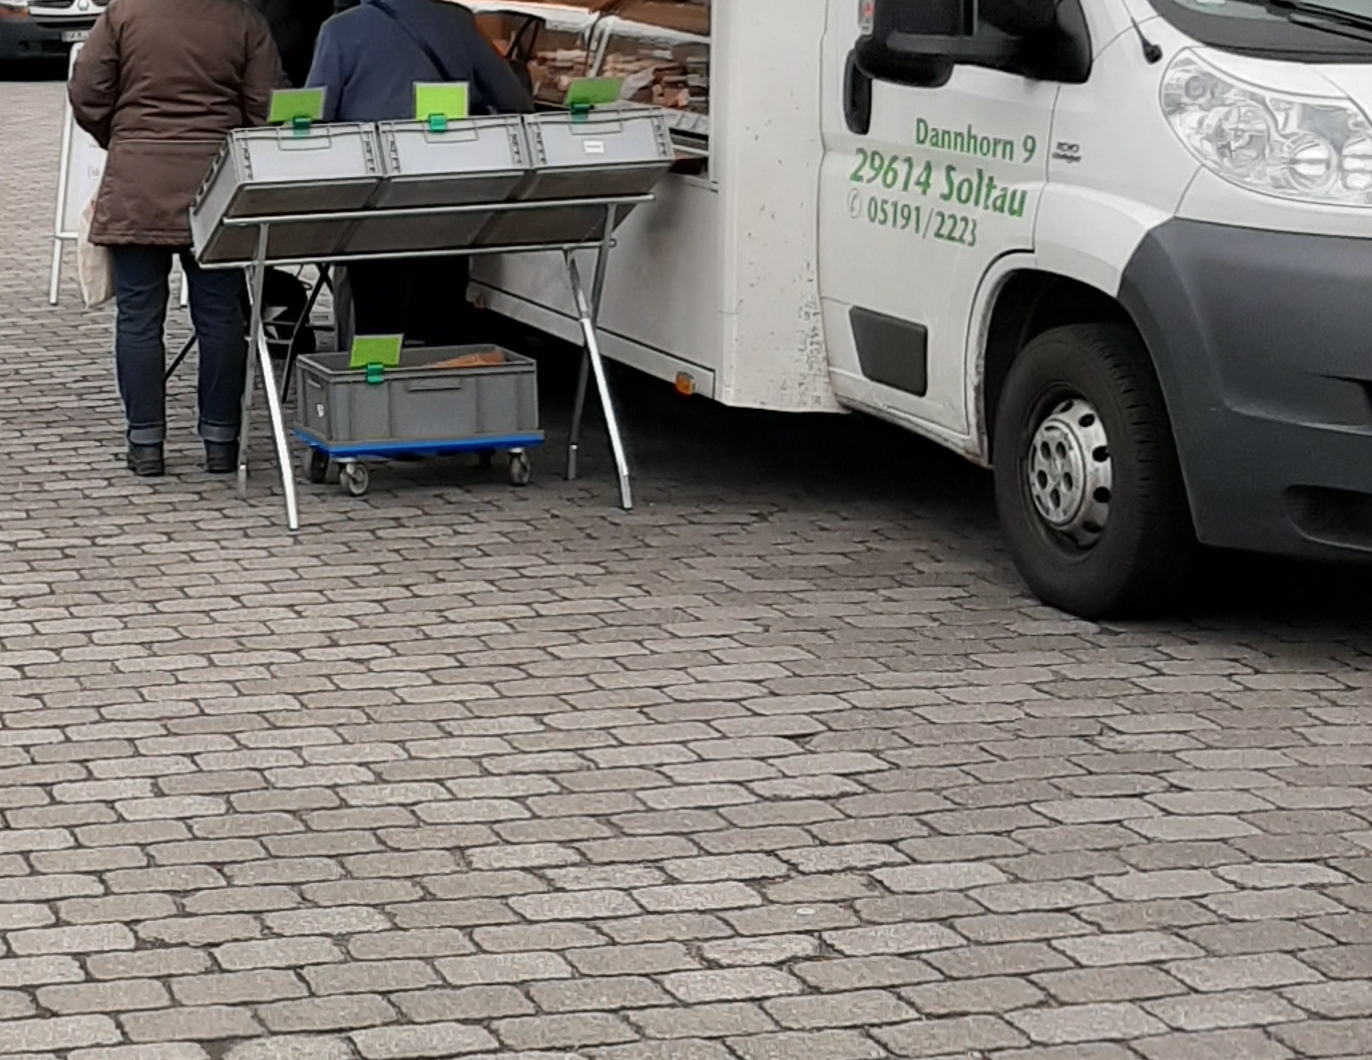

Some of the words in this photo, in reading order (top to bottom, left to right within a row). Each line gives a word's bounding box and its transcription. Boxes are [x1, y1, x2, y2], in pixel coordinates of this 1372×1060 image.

[915, 117, 1016, 162] Dannhorn
[1022, 134, 1037, 164] 9
[849, 147, 933, 197] 29614
[939, 163, 1028, 218] Soltau
[866, 196, 978, 248] 05191/2223
